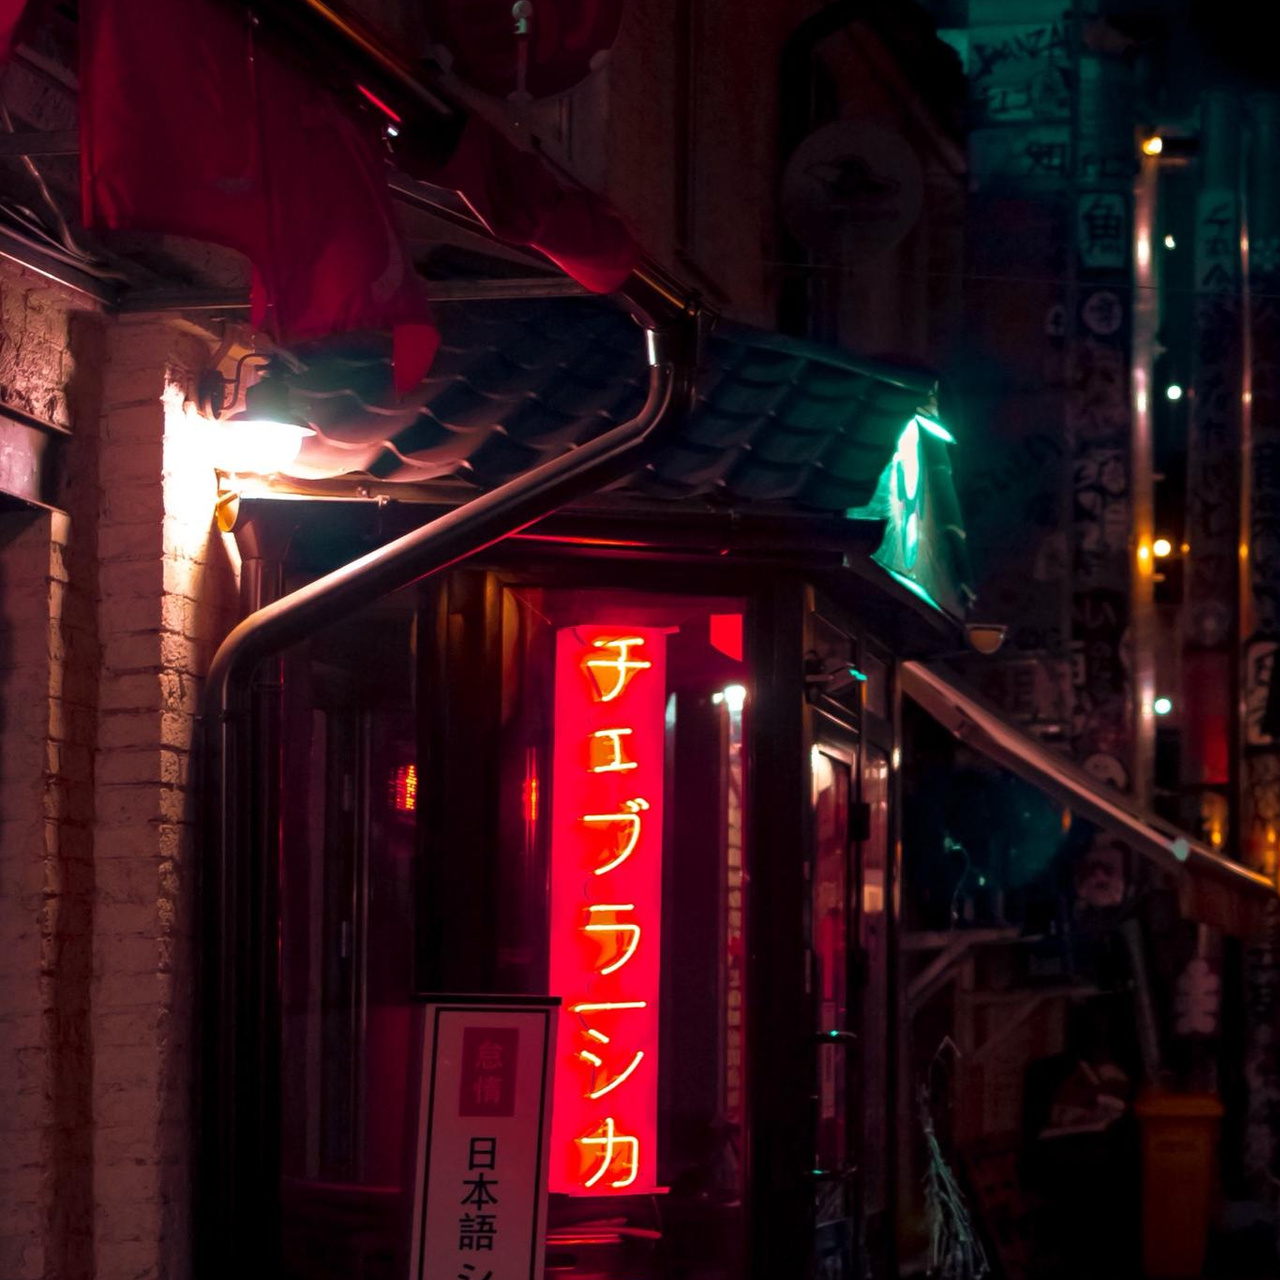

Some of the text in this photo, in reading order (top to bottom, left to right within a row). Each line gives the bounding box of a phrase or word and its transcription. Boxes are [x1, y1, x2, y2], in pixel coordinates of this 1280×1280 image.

[572, 635, 652, 1190] チェブラーシカ
